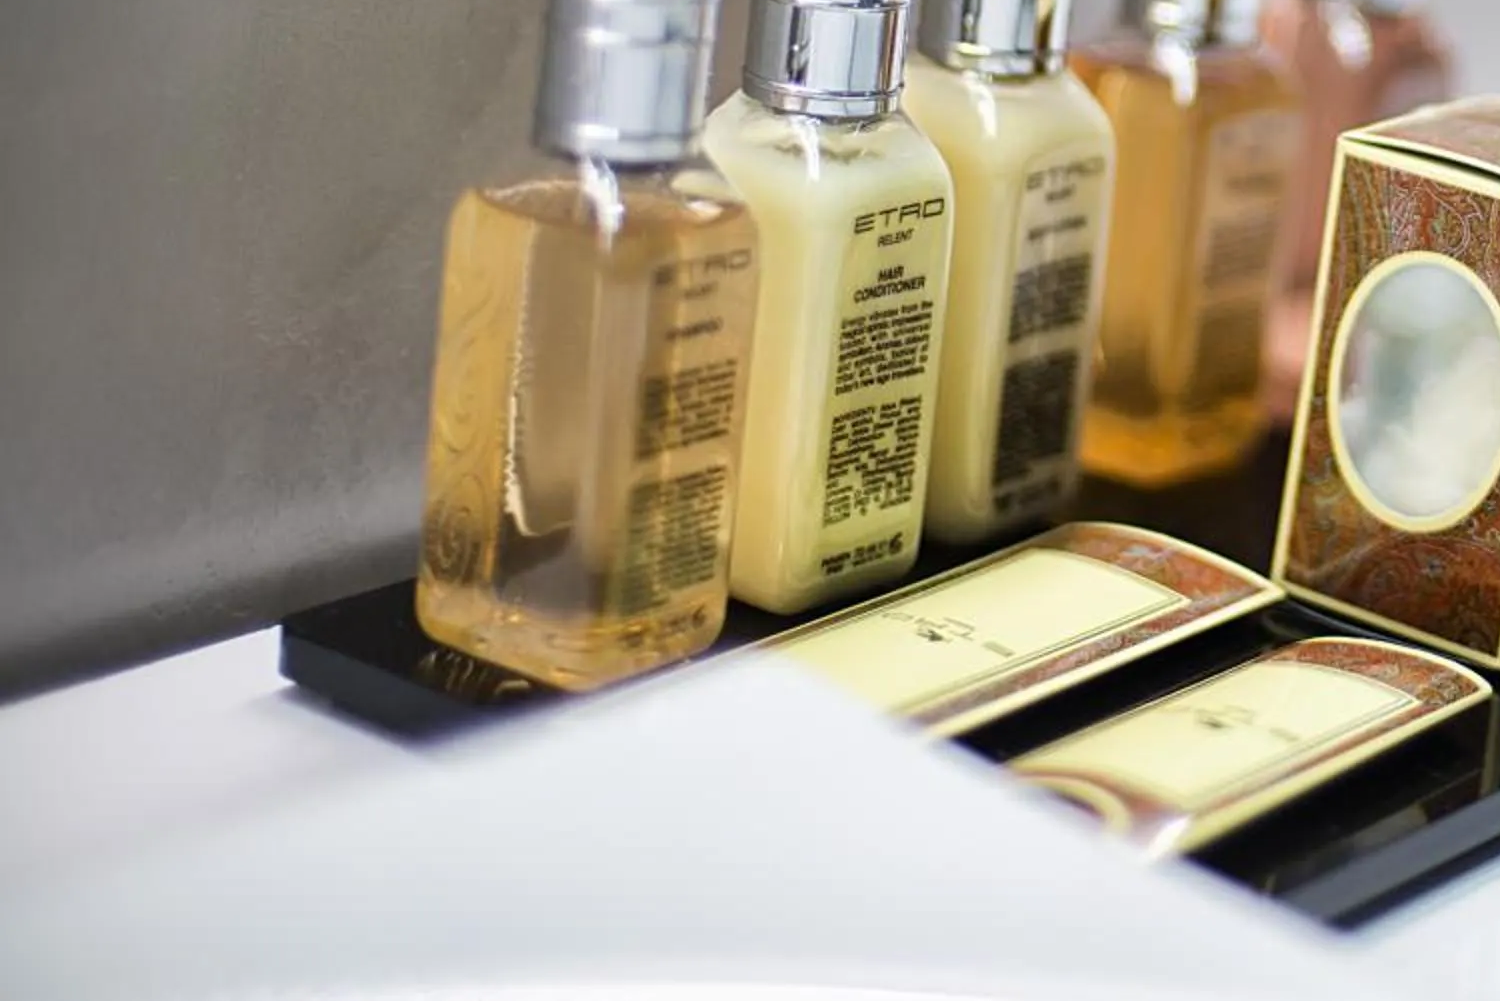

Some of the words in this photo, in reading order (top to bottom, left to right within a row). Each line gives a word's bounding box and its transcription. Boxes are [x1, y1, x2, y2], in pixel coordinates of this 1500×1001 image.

[854, 197, 944, 234] ETRO
[878, 228, 914, 247] RELENT
[878, 265, 904, 282] HAIR
[853, 276, 925, 303] CONDITIONER
